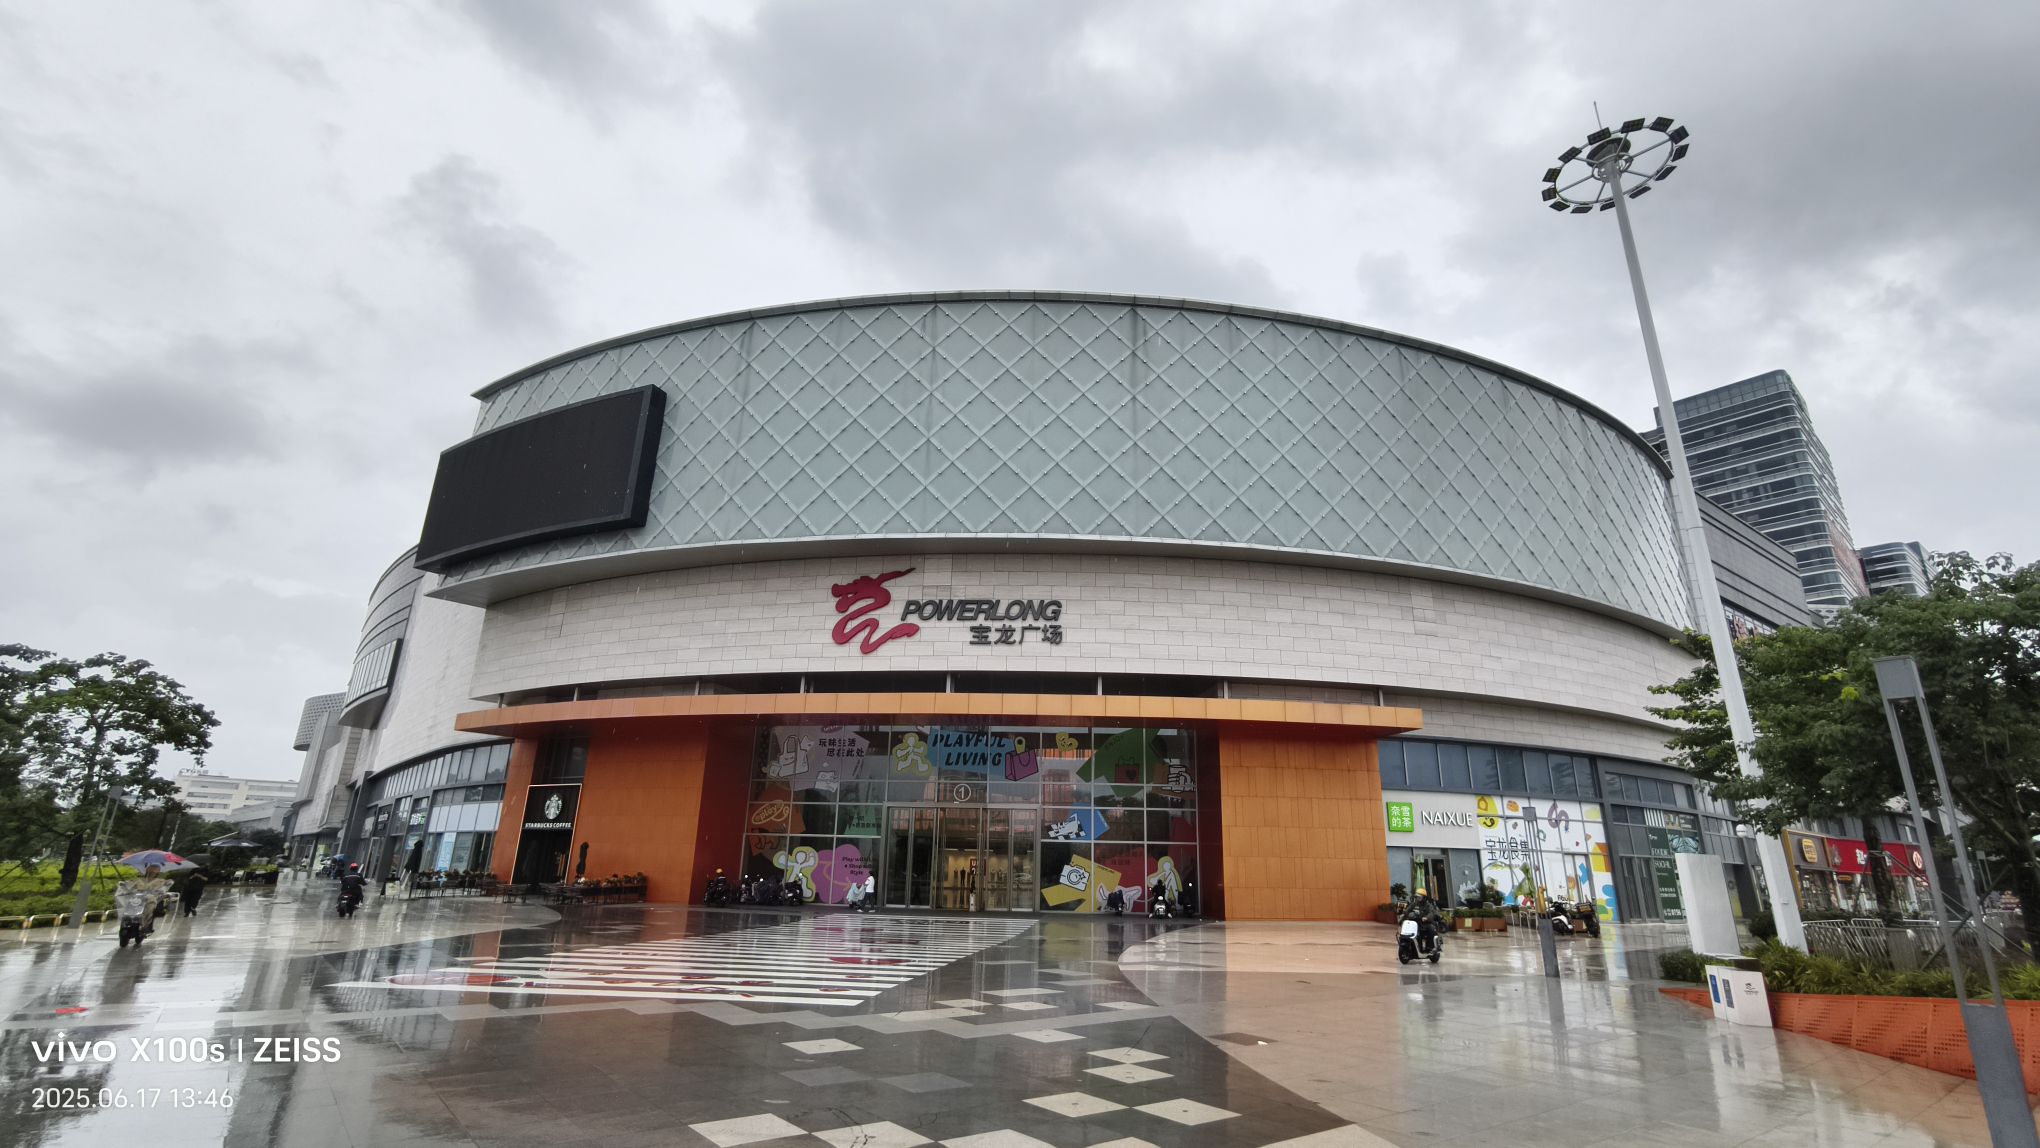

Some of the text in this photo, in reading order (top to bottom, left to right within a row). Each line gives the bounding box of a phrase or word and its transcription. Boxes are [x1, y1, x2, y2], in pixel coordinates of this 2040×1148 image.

[900, 599, 1063, 621] POWERLONG
[969, 623, 1063, 645] 宝龙广场
[932, 733, 1006, 748] PLAYFUL
[944, 751, 1002, 766] LIVING
[1390, 805, 1411, 817] 奈雪
[1421, 810, 1473, 827] NAIXUE
[1391, 816, 1412, 828] 的茶
